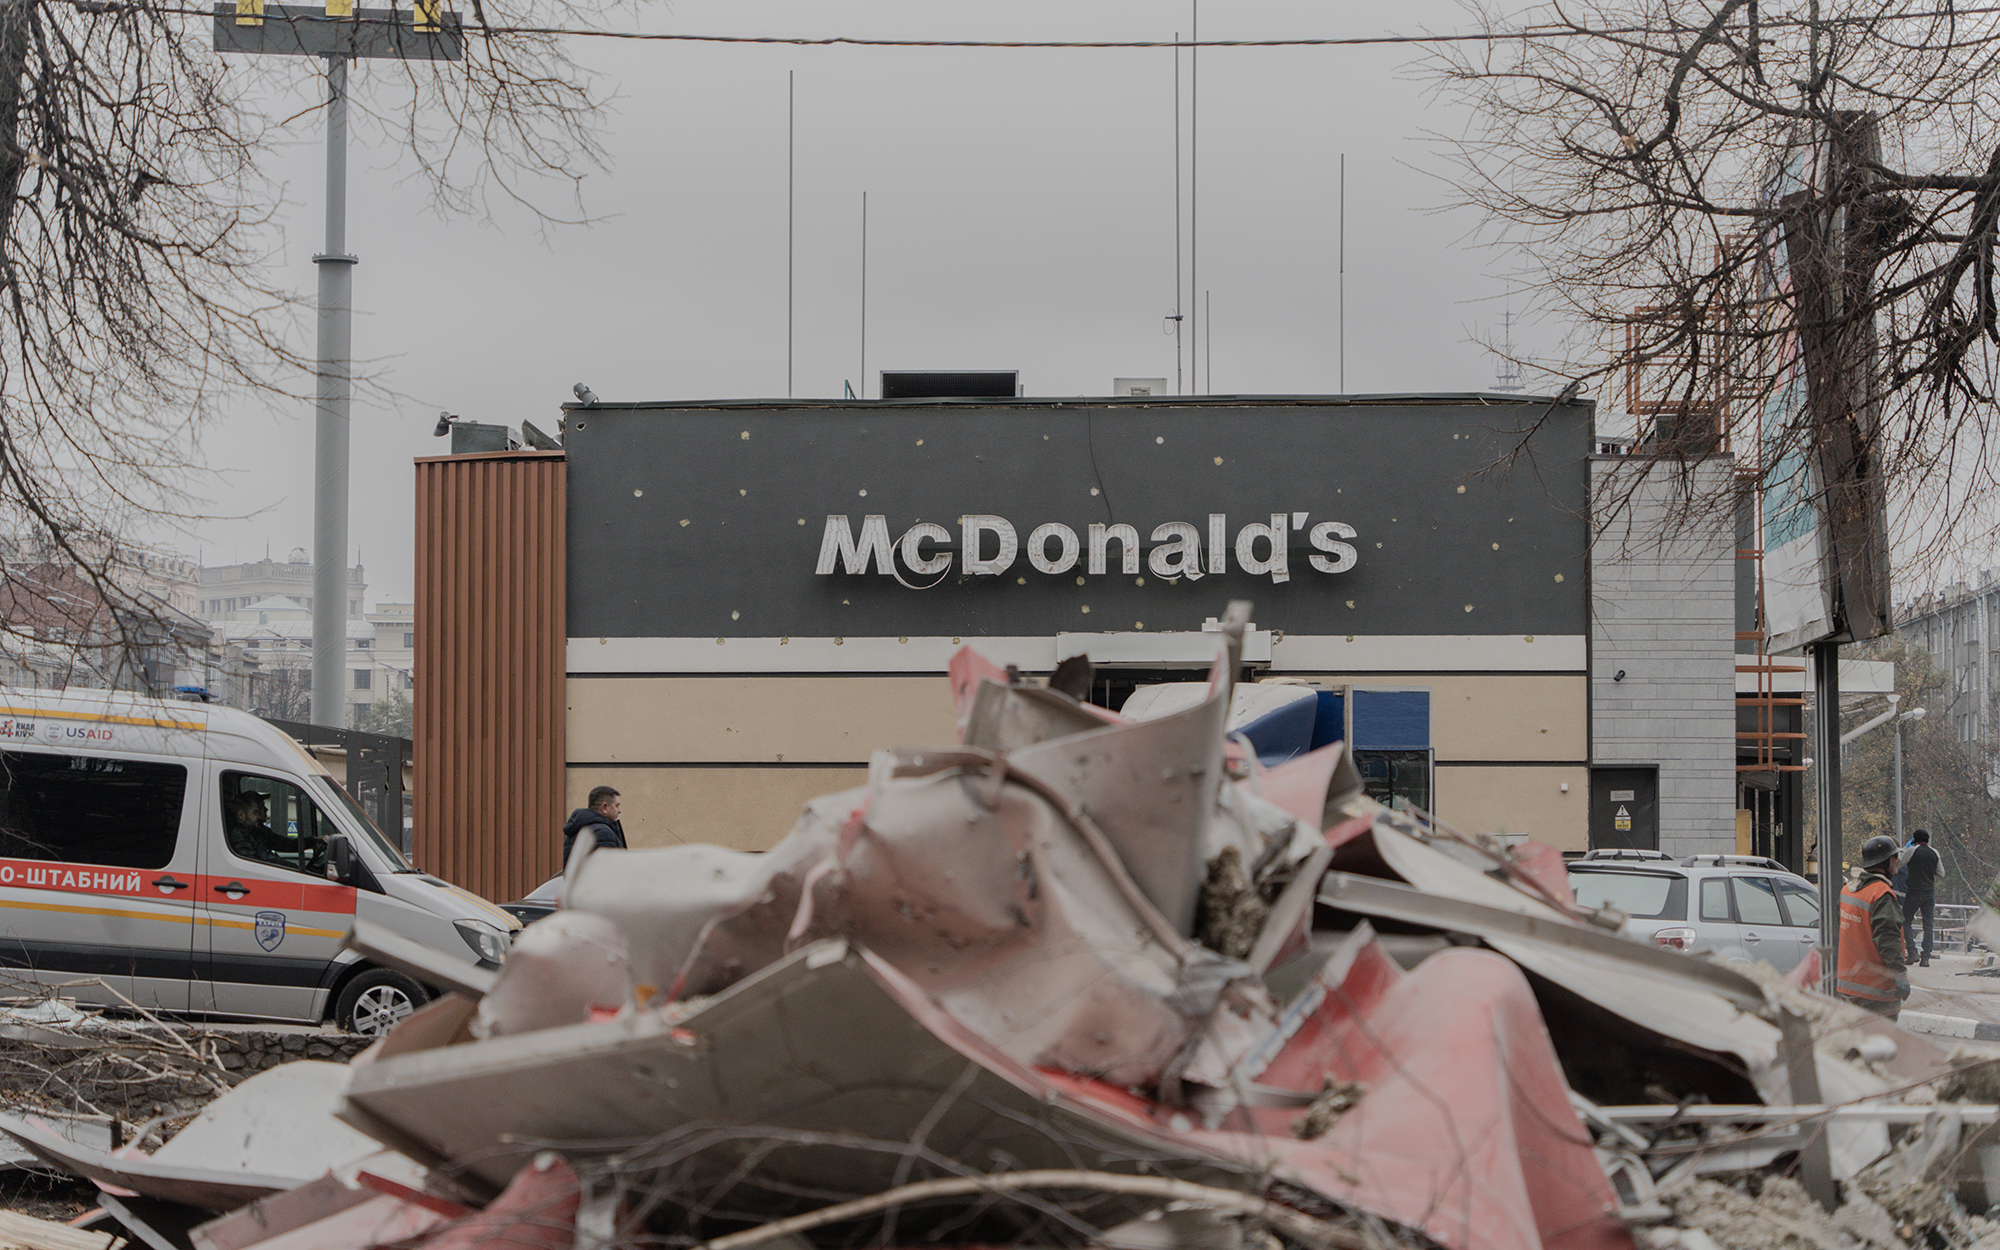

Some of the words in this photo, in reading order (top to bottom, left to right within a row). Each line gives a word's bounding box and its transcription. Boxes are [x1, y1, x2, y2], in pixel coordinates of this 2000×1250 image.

[814, 512, 1358, 580] McDonald's
[15, 722, 35, 730] KHAR
[66, 727, 112, 740] USAID
[0, 866, 141, 892] О-ШТАБНИЙ
